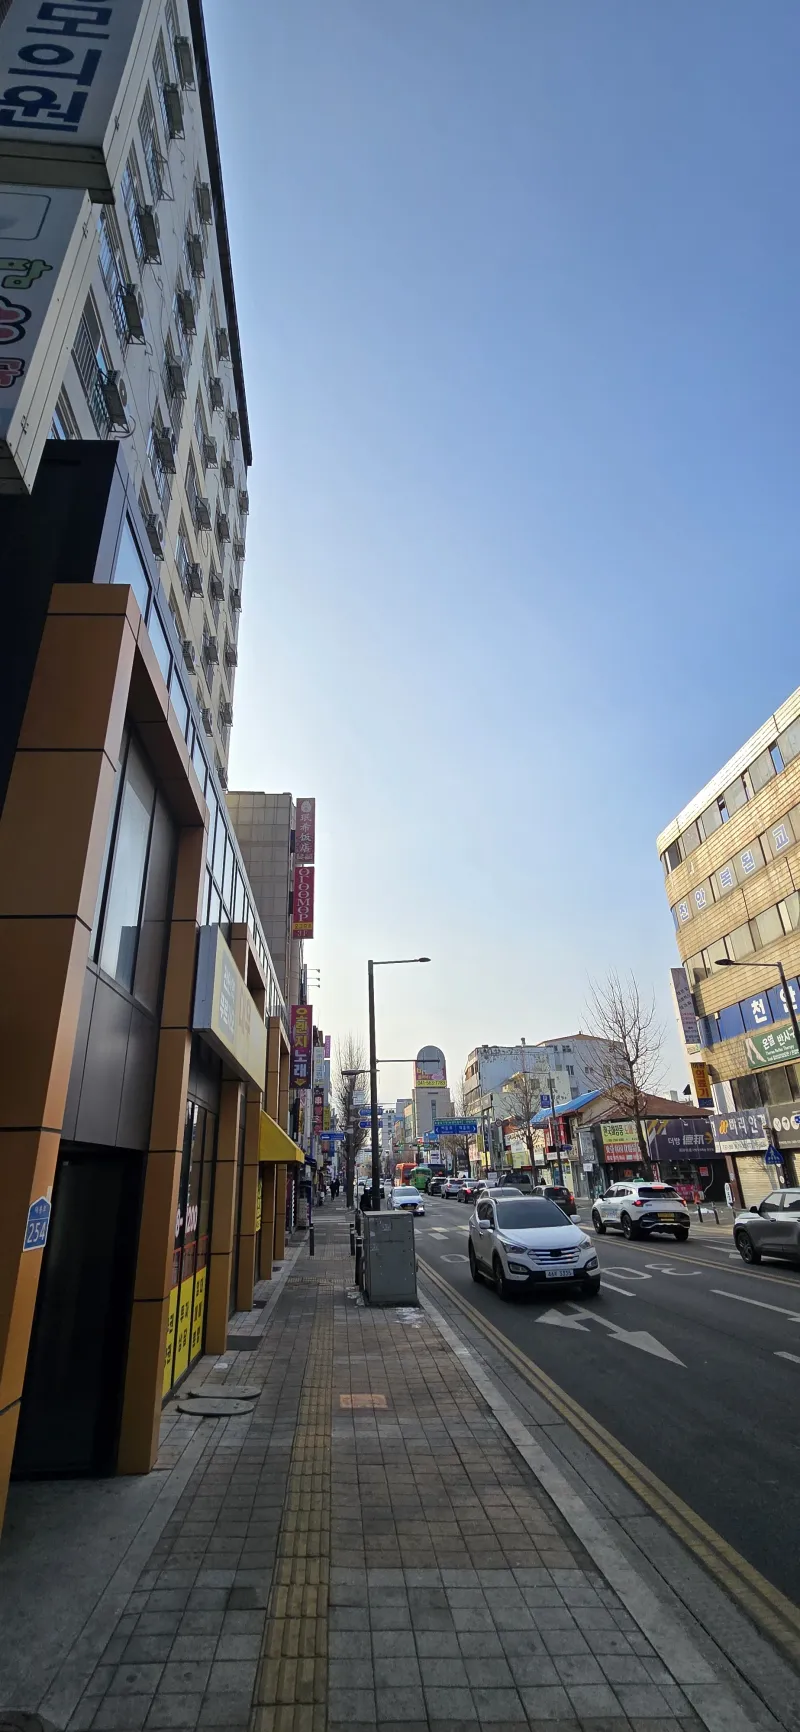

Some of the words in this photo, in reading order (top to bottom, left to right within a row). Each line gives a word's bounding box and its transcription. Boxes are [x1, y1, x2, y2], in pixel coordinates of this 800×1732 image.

[0, 0, 112, 132] 모의원
[295, 1008, 308, 1048] 오렌지
[294, 1050, 308, 1077] 노래
[27, 1222, 46, 1243] 254
